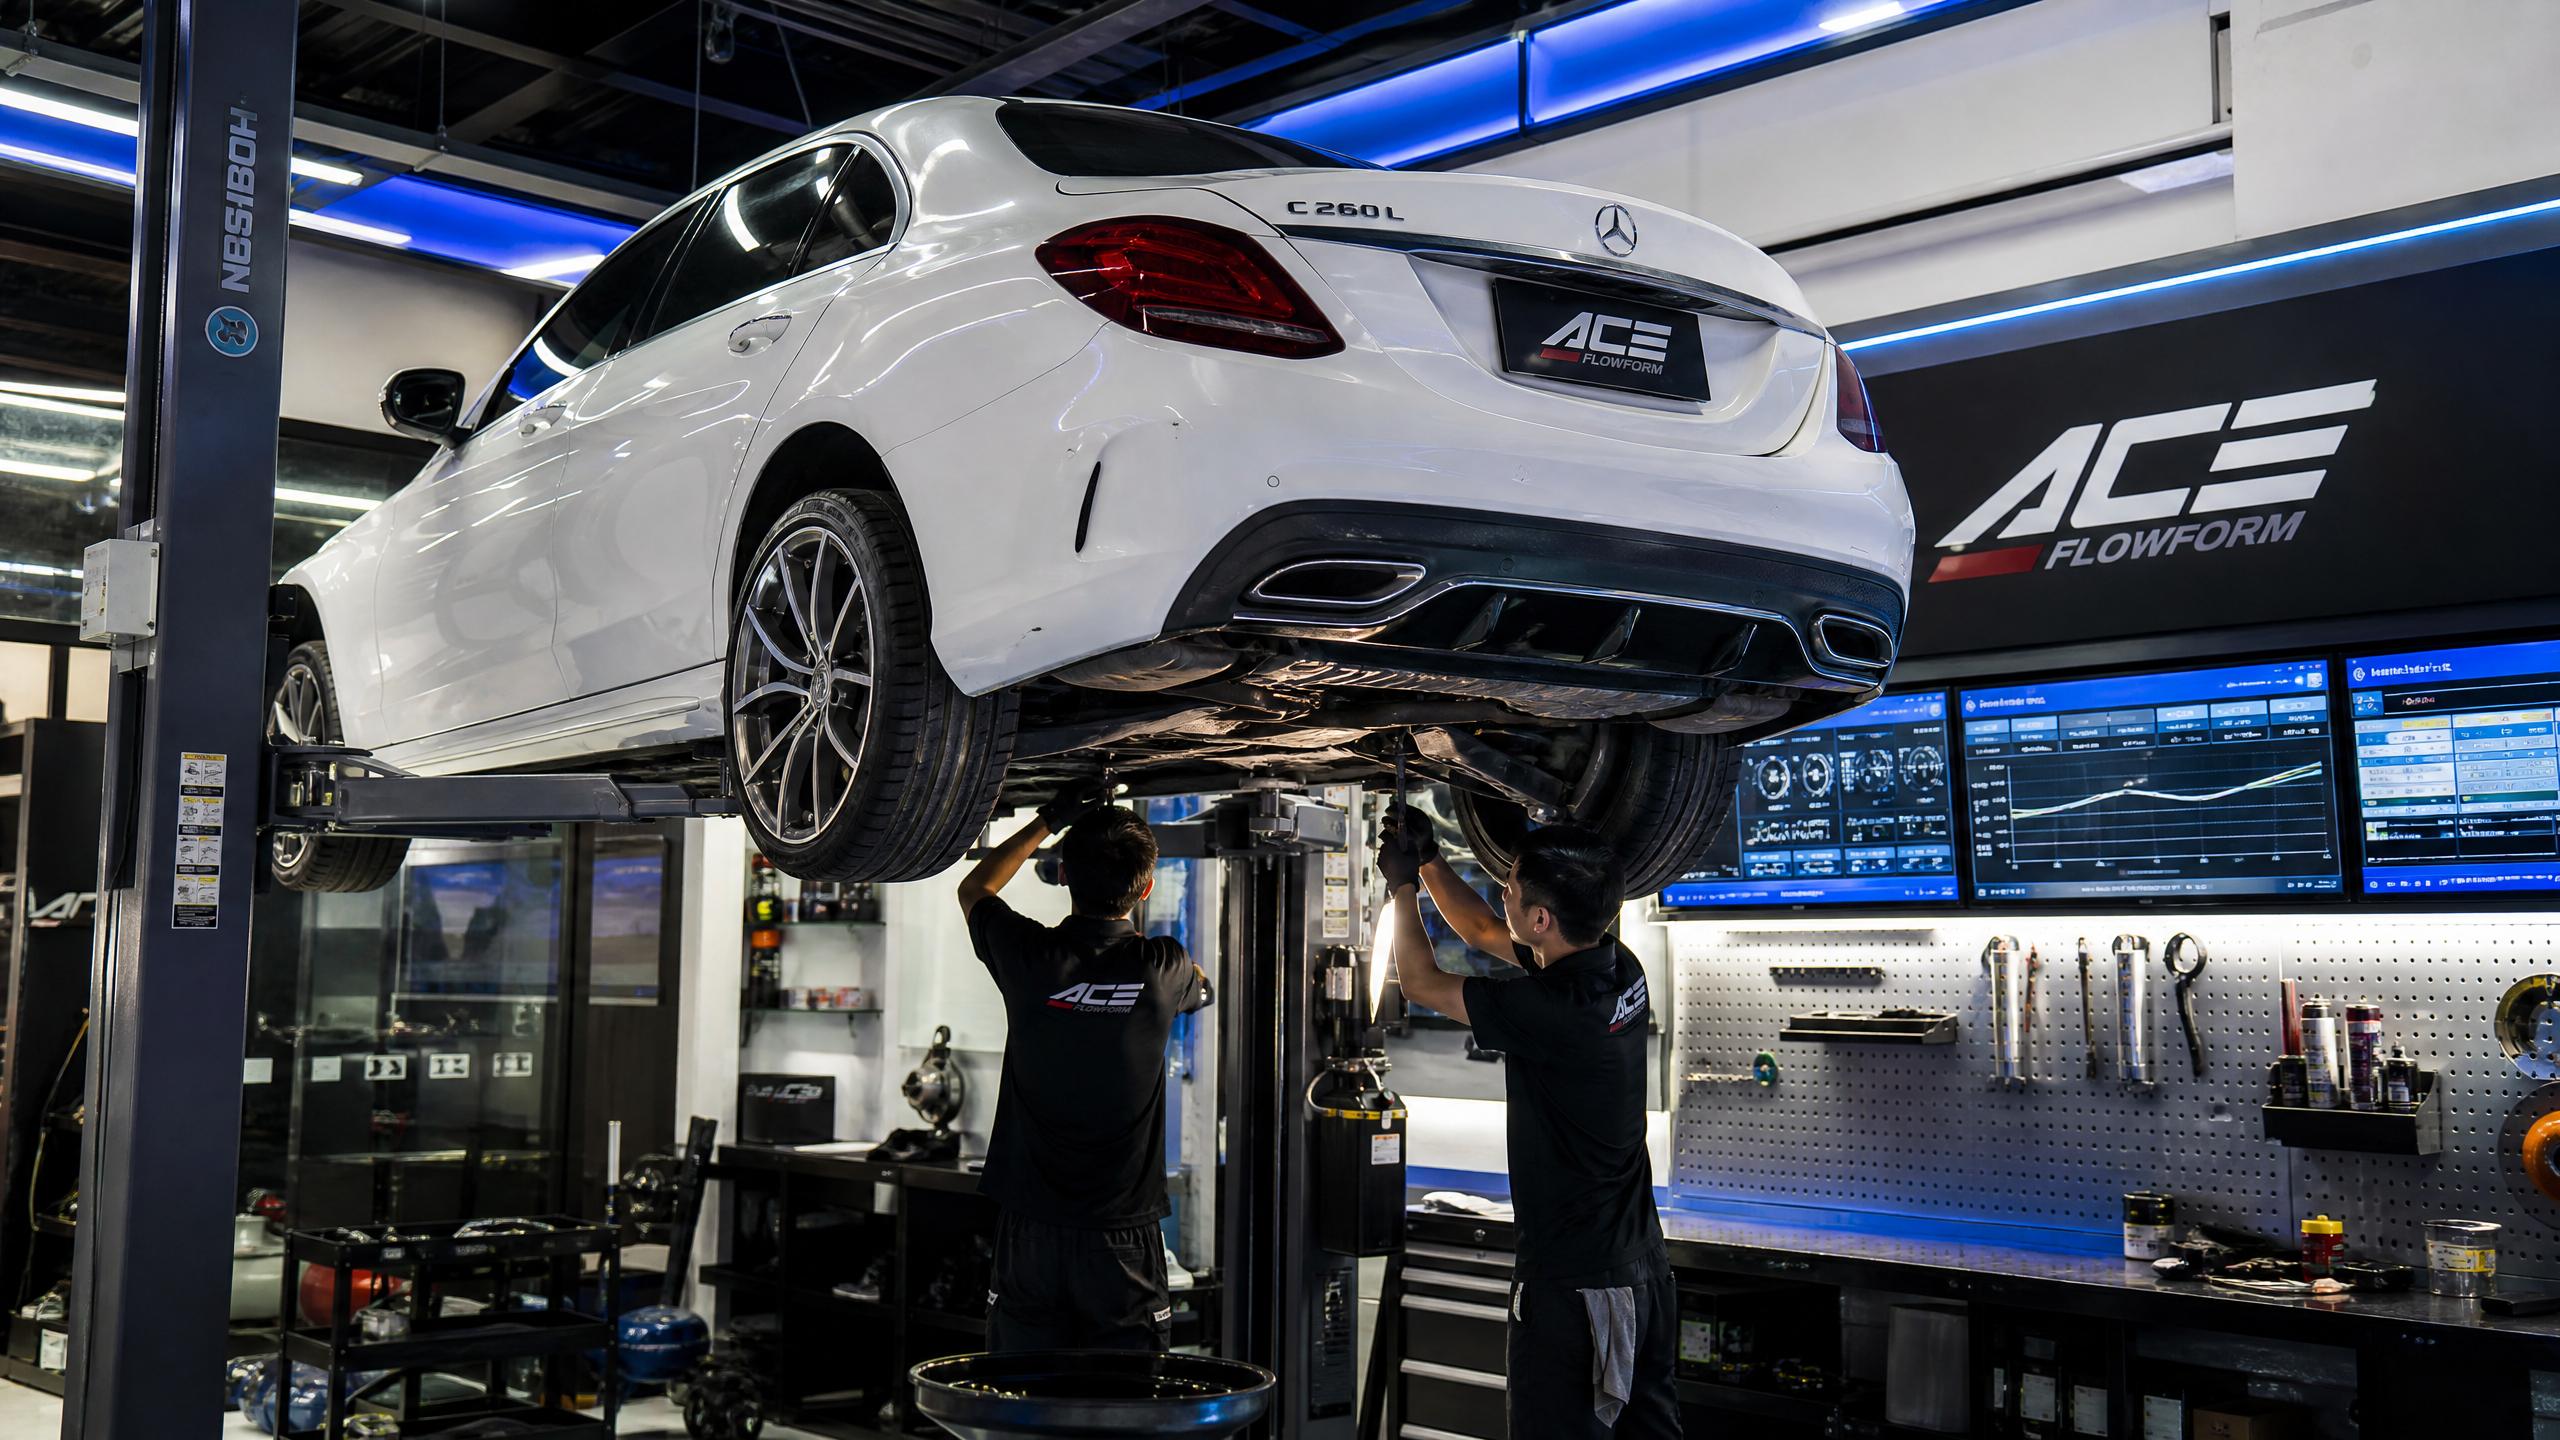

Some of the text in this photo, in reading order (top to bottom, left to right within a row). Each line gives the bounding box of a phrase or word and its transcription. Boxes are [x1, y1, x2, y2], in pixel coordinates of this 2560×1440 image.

[1287, 201, 1308, 214] C
[1541, 311, 1672, 362] ACE
[1582, 353, 1664, 375] FLOWFORM
[1934, 378, 2377, 548] ACE
[2044, 511, 2307, 570] FLOWFORM
[1049, 982, 1145, 1006] ACE
[1073, 1004, 1132, 1014] FLOWFORM
[1609, 974, 1646, 1025] ACE
